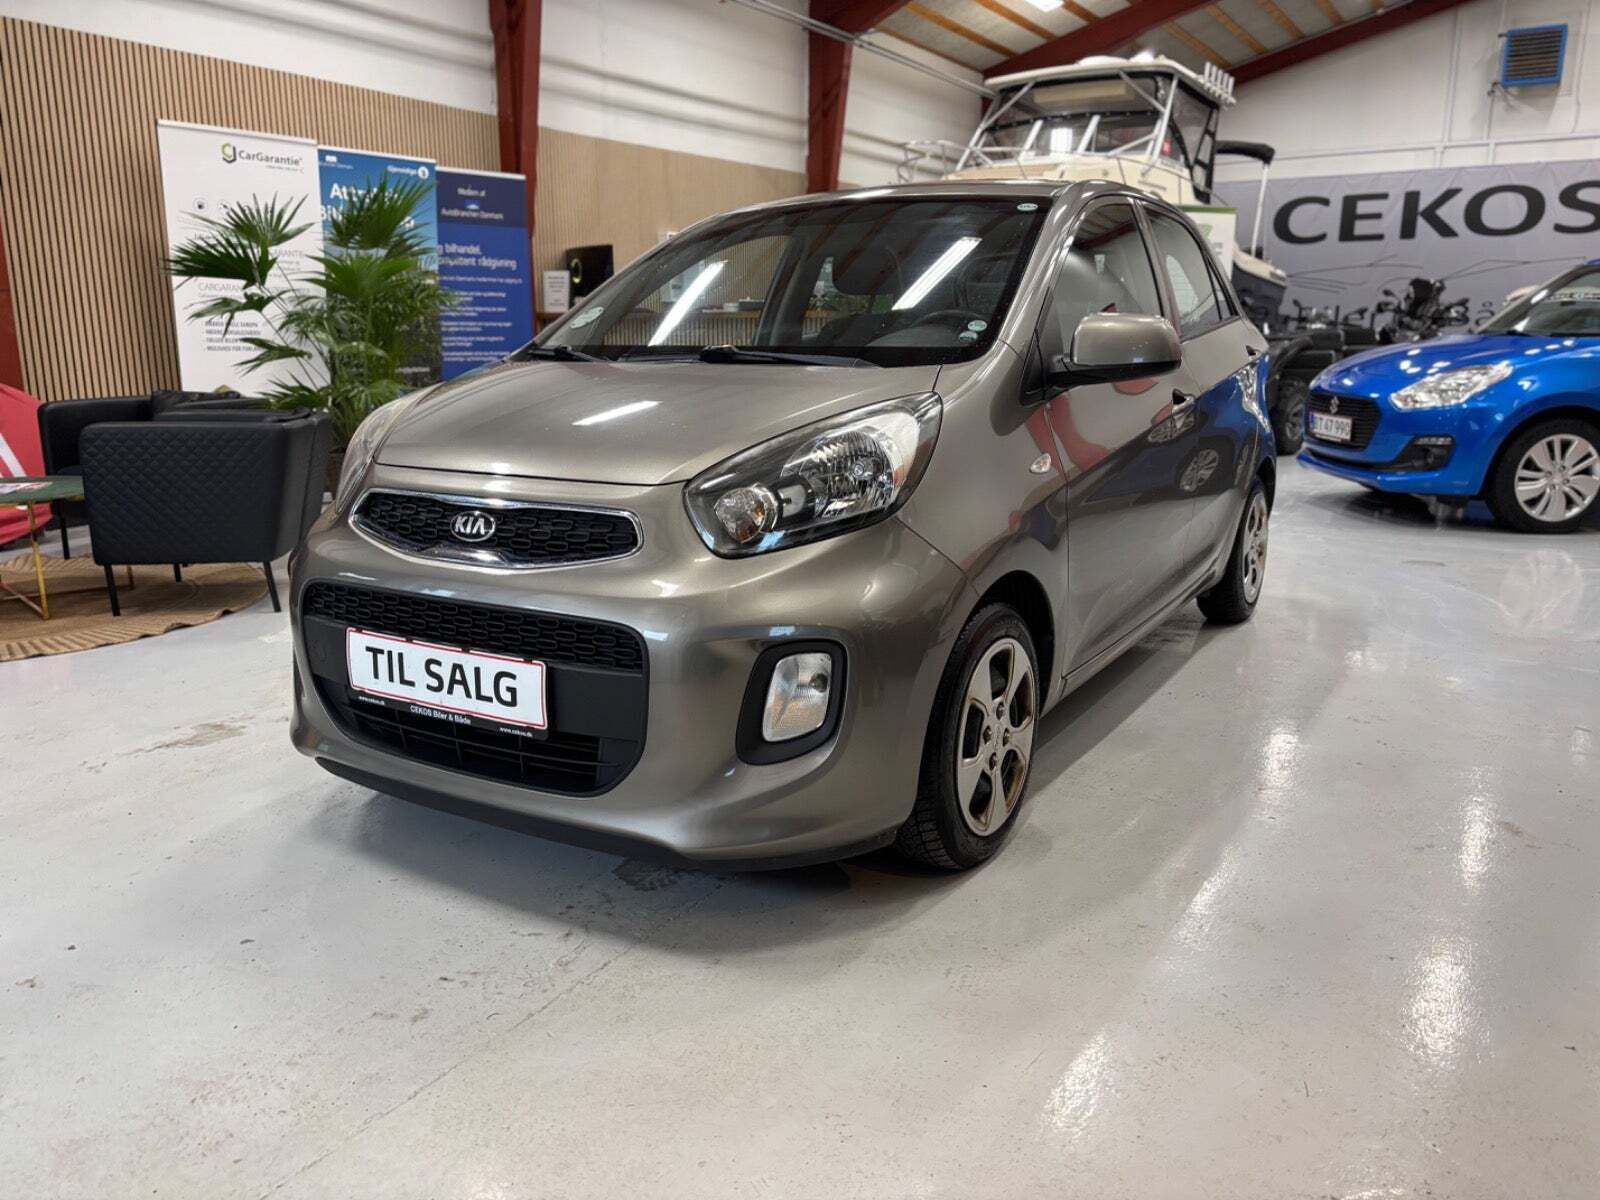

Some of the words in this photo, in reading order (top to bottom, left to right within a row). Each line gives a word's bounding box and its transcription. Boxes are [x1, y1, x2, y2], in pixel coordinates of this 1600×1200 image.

[238, 149, 301, 166] CarGarantie
[1272, 180, 1600, 245] CEKOS
[454, 516, 485, 535] KIA
[365, 646, 416, 687] TIL
[424, 657, 518, 707] SALG
[410, 704, 432, 717] CEKOS
[433, 710, 447, 720] Biler
[448, 713, 453, 721] &
[454, 713, 471, 725] Både
